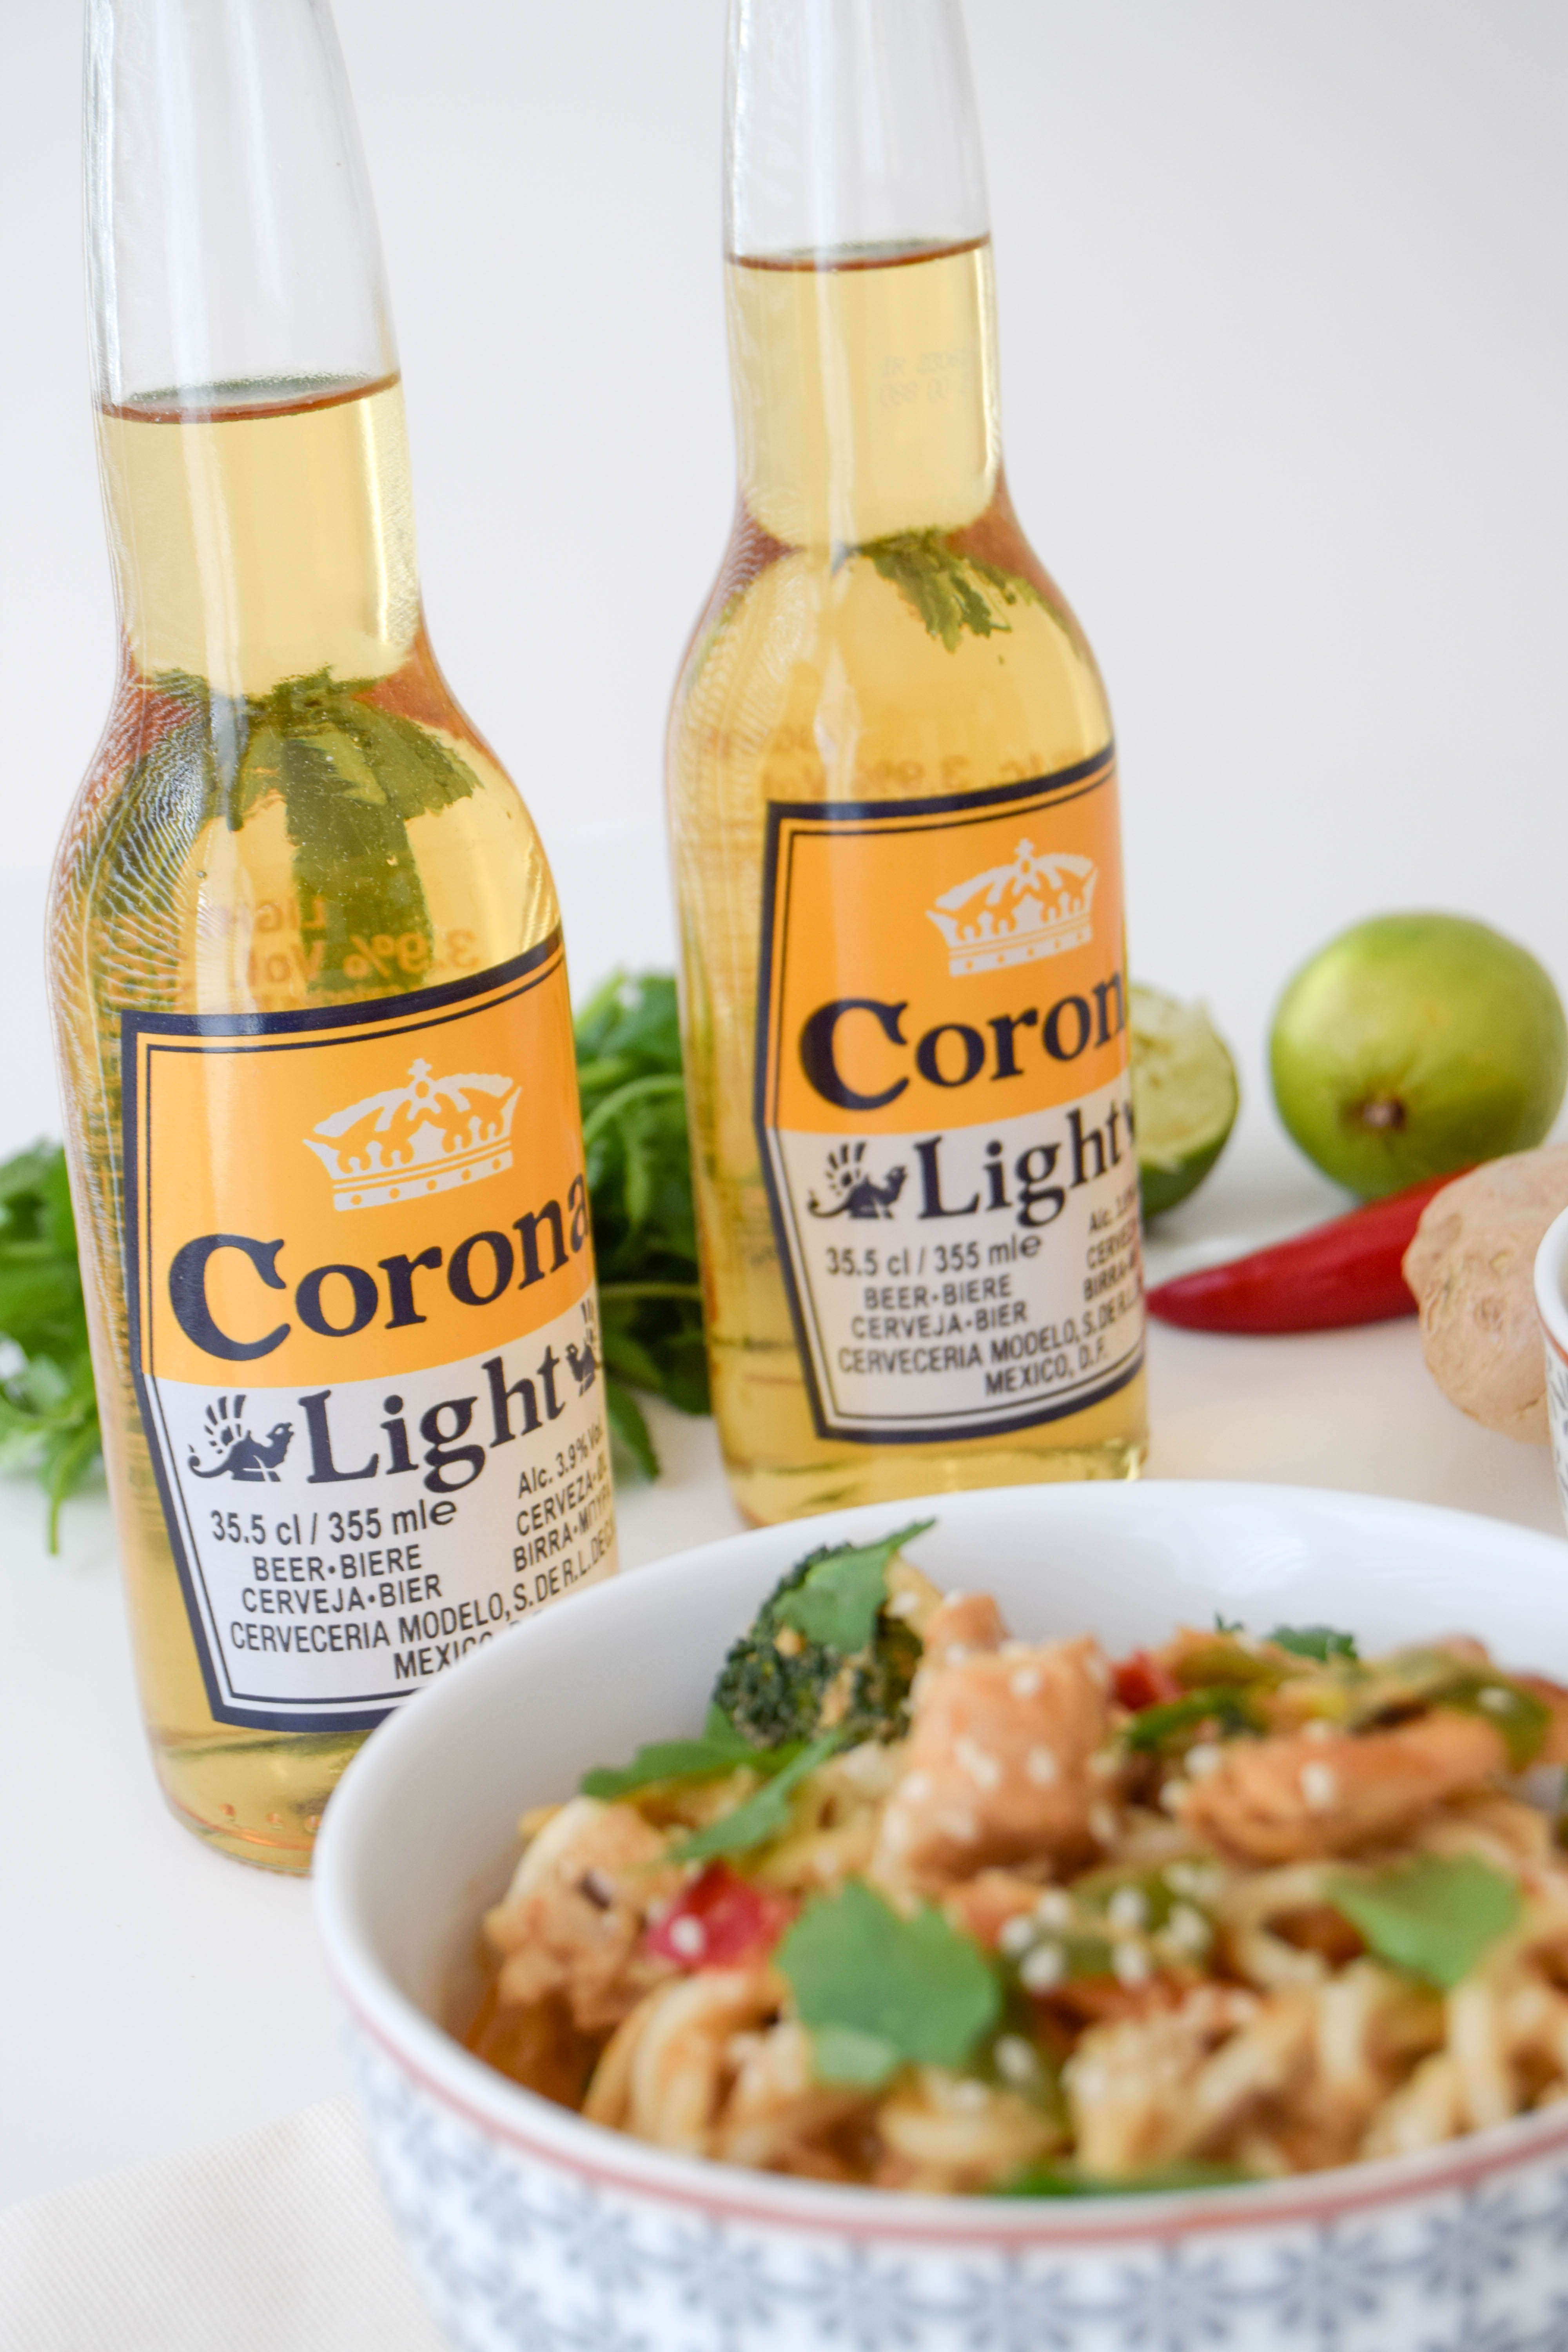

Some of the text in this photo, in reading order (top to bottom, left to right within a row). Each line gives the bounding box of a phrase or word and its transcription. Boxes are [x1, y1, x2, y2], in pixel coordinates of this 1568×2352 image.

[913, 1098, 1122, 1228] Light
[169, 1173, 589, 1362] Corona
[826, 1246, 878, 1277] 35.5
[887, 1247, 910, 1277] cl
[933, 1240, 979, 1273] 355
[837, 1341, 983, 1374] CERVECERIA
[989, 1317, 1081, 1364] MODELO,
[985, 1352, 1074, 1397] MEXICO,
[298, 1344, 566, 1494] Light
[518, 1466, 554, 1499] Alc.
[555, 1432, 588, 1479] 3.9%
[210, 1509, 266, 1545] 35.5
[276, 1513, 301, 1546] cl
[328, 1507, 383, 1544] 355
[229, 1620, 391, 1653] CERVECERIA
[397, 1592, 512, 1644] MODELO,
